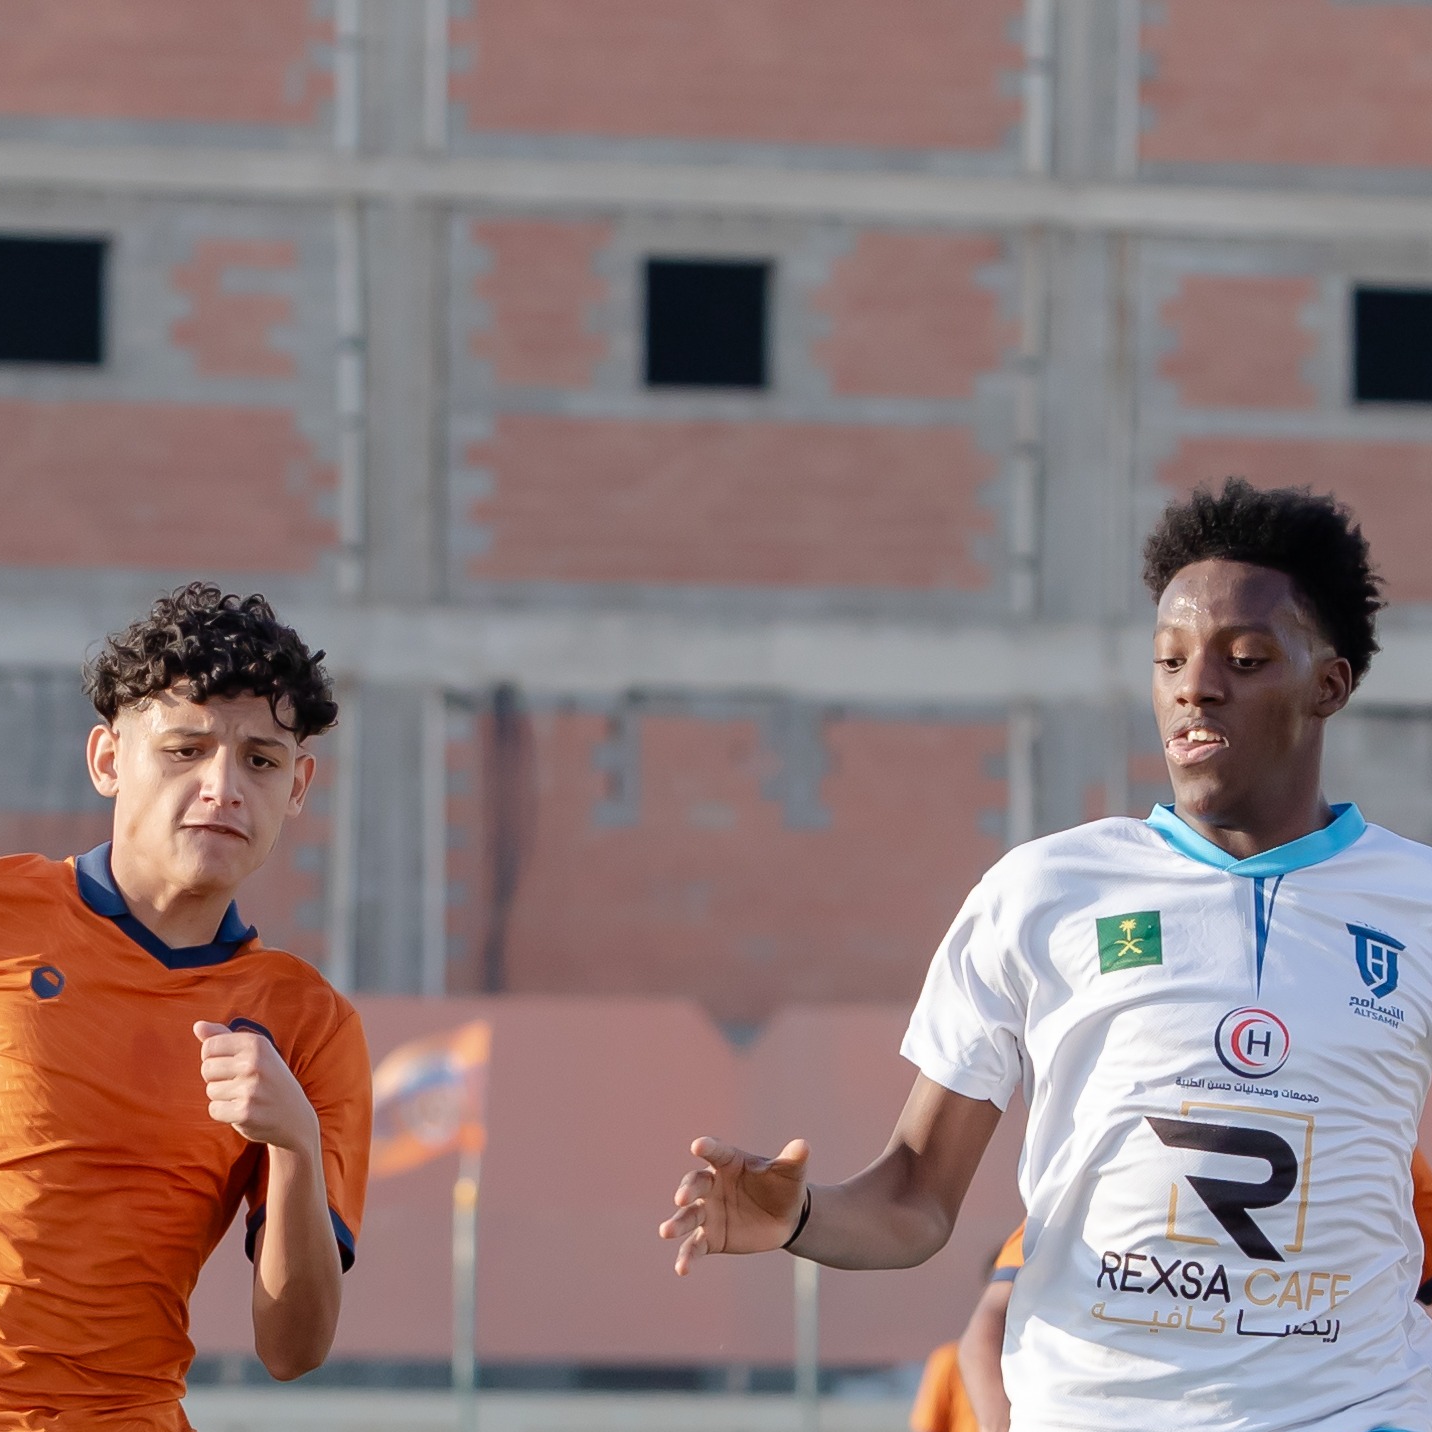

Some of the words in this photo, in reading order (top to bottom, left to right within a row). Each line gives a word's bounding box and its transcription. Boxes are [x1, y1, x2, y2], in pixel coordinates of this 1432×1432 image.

[1349, 996, 1404, 1021] التسامح
[1354, 1007, 1399, 1029] ALTSAMH
[1247, 1029, 1271, 1057] H
[1175, 1076, 1205, 1089] الطبية
[1207, 1079, 1231, 1092] حسن
[1234, 1082, 1279, 1097] وصيدليات
[1281, 1088, 1319, 1103] مجمعات
[1144, 1116, 1298, 1262] R
[1097, 1250, 1231, 1303] REXSA
